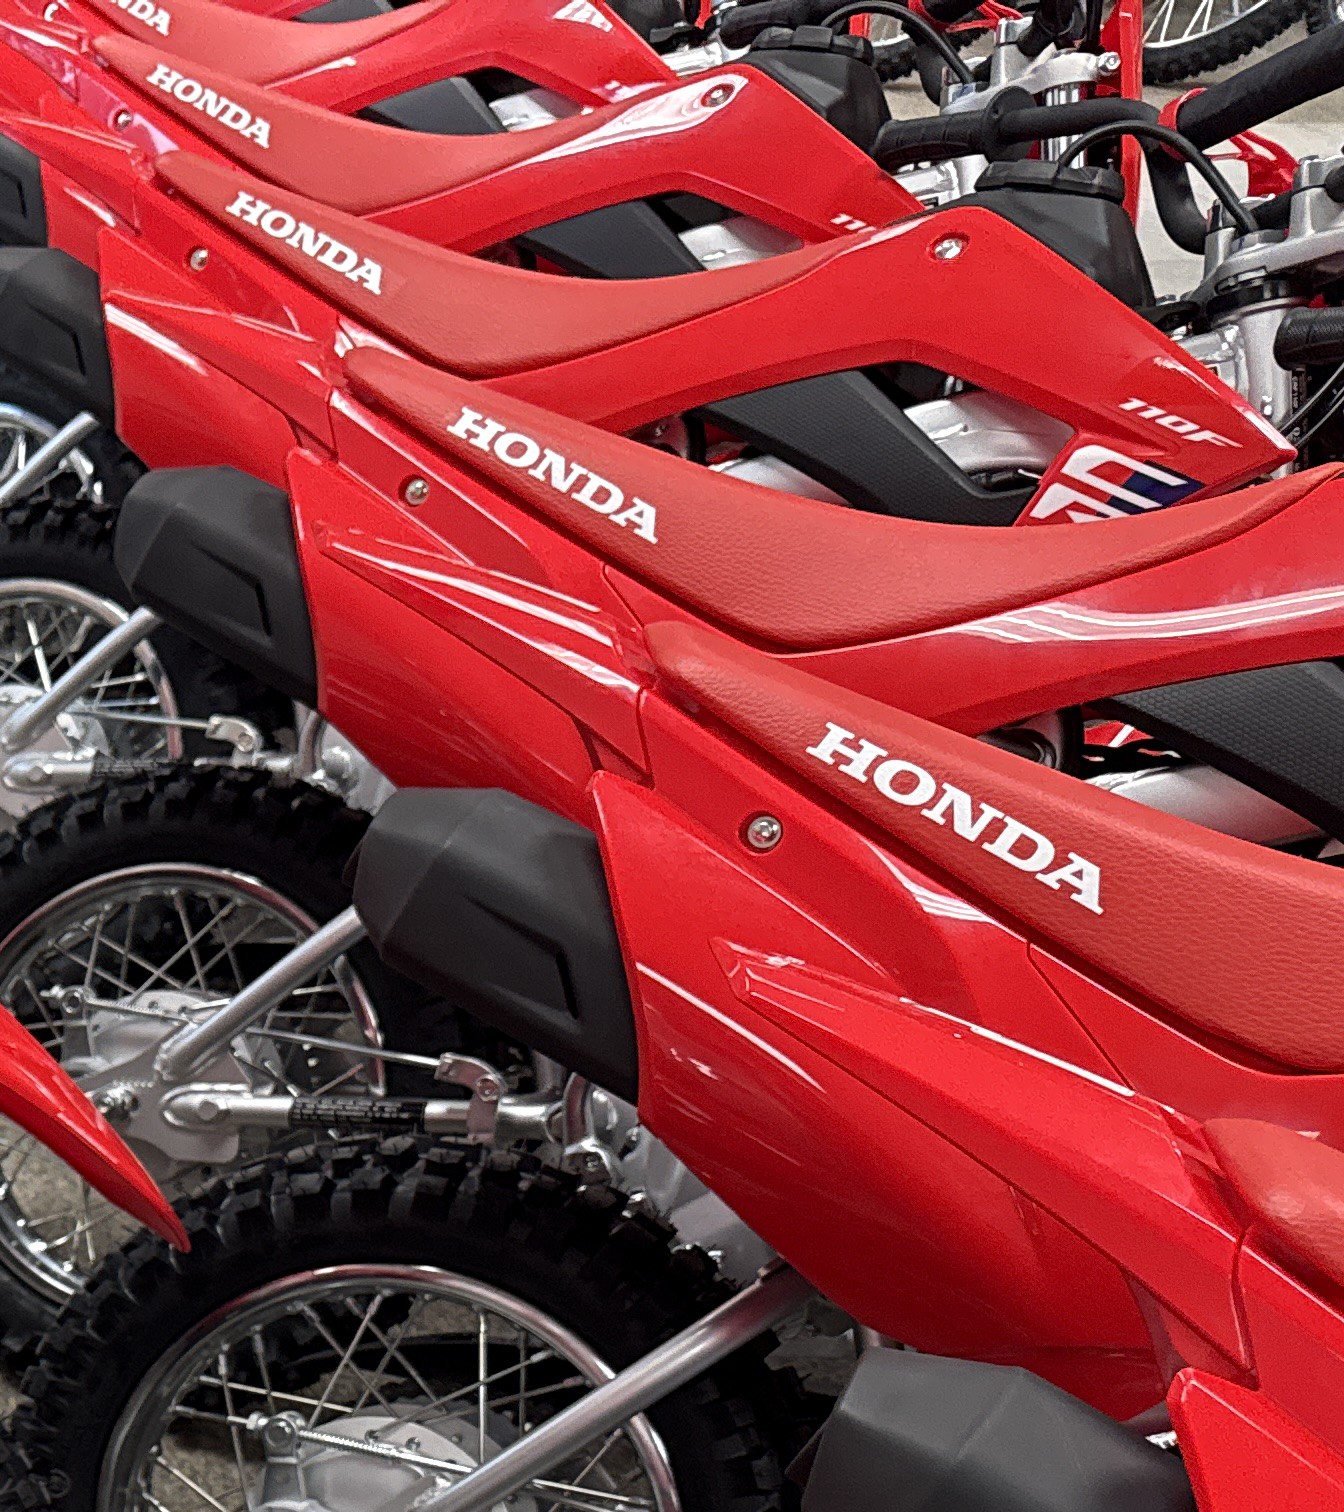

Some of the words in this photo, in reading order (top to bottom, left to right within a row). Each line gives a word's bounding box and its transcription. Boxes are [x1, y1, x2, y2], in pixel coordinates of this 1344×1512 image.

[147, 63, 270, 148] HONDA
[225, 191, 383, 296] HONDA
[1119, 397, 1243, 448] 110F
[447, 407, 659, 546] HONDA
[806, 722, 1106, 916] HONDA
